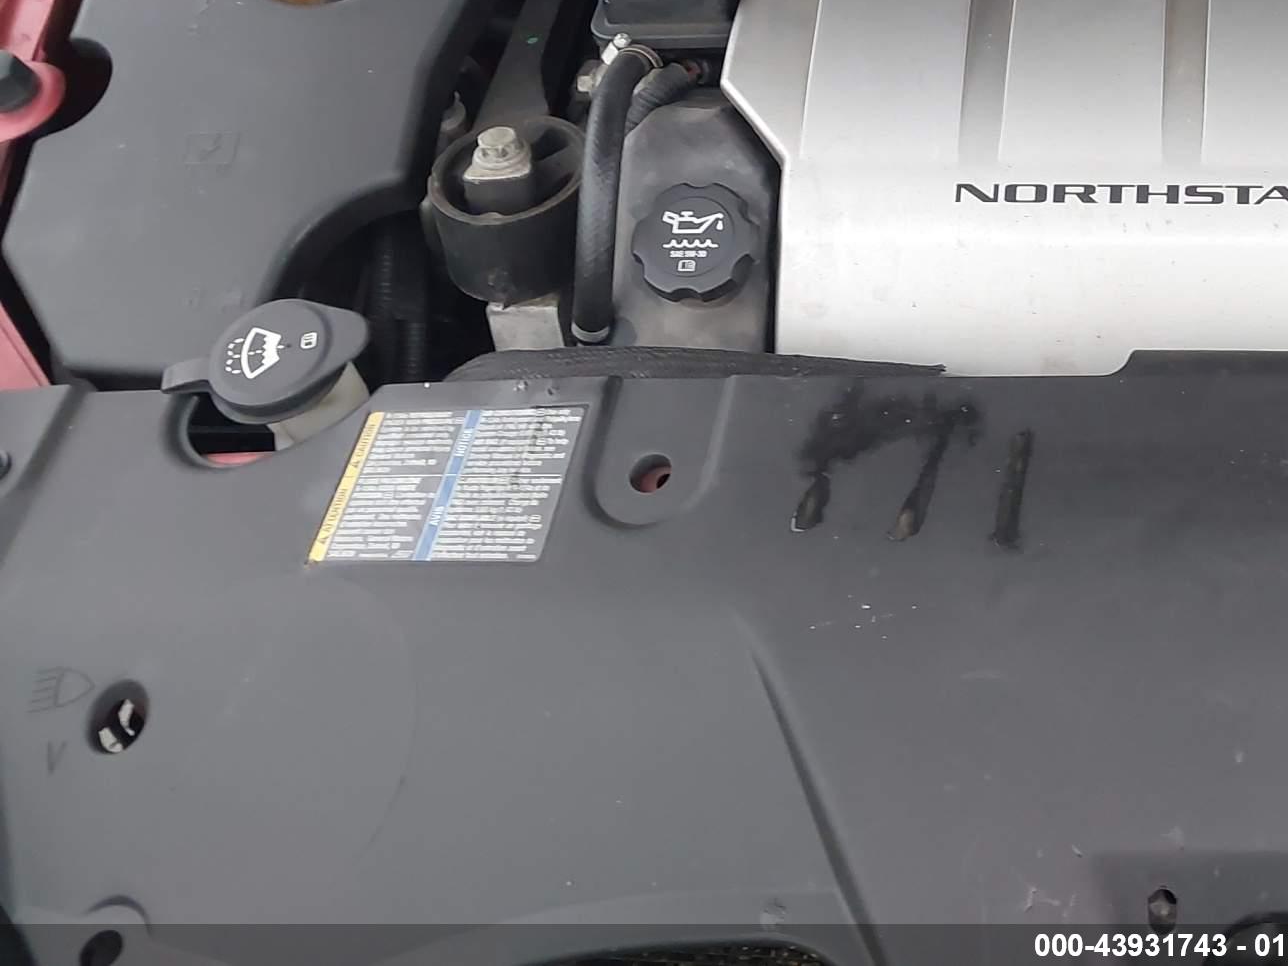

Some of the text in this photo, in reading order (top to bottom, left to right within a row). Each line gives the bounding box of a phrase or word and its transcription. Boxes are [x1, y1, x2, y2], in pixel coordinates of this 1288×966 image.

[356, 423, 377, 456] CAUTION
[455, 428, 473, 456] NOTICE
[323, 487, 348, 532] ATTENTION
[429, 505, 444, 526] AVIS
